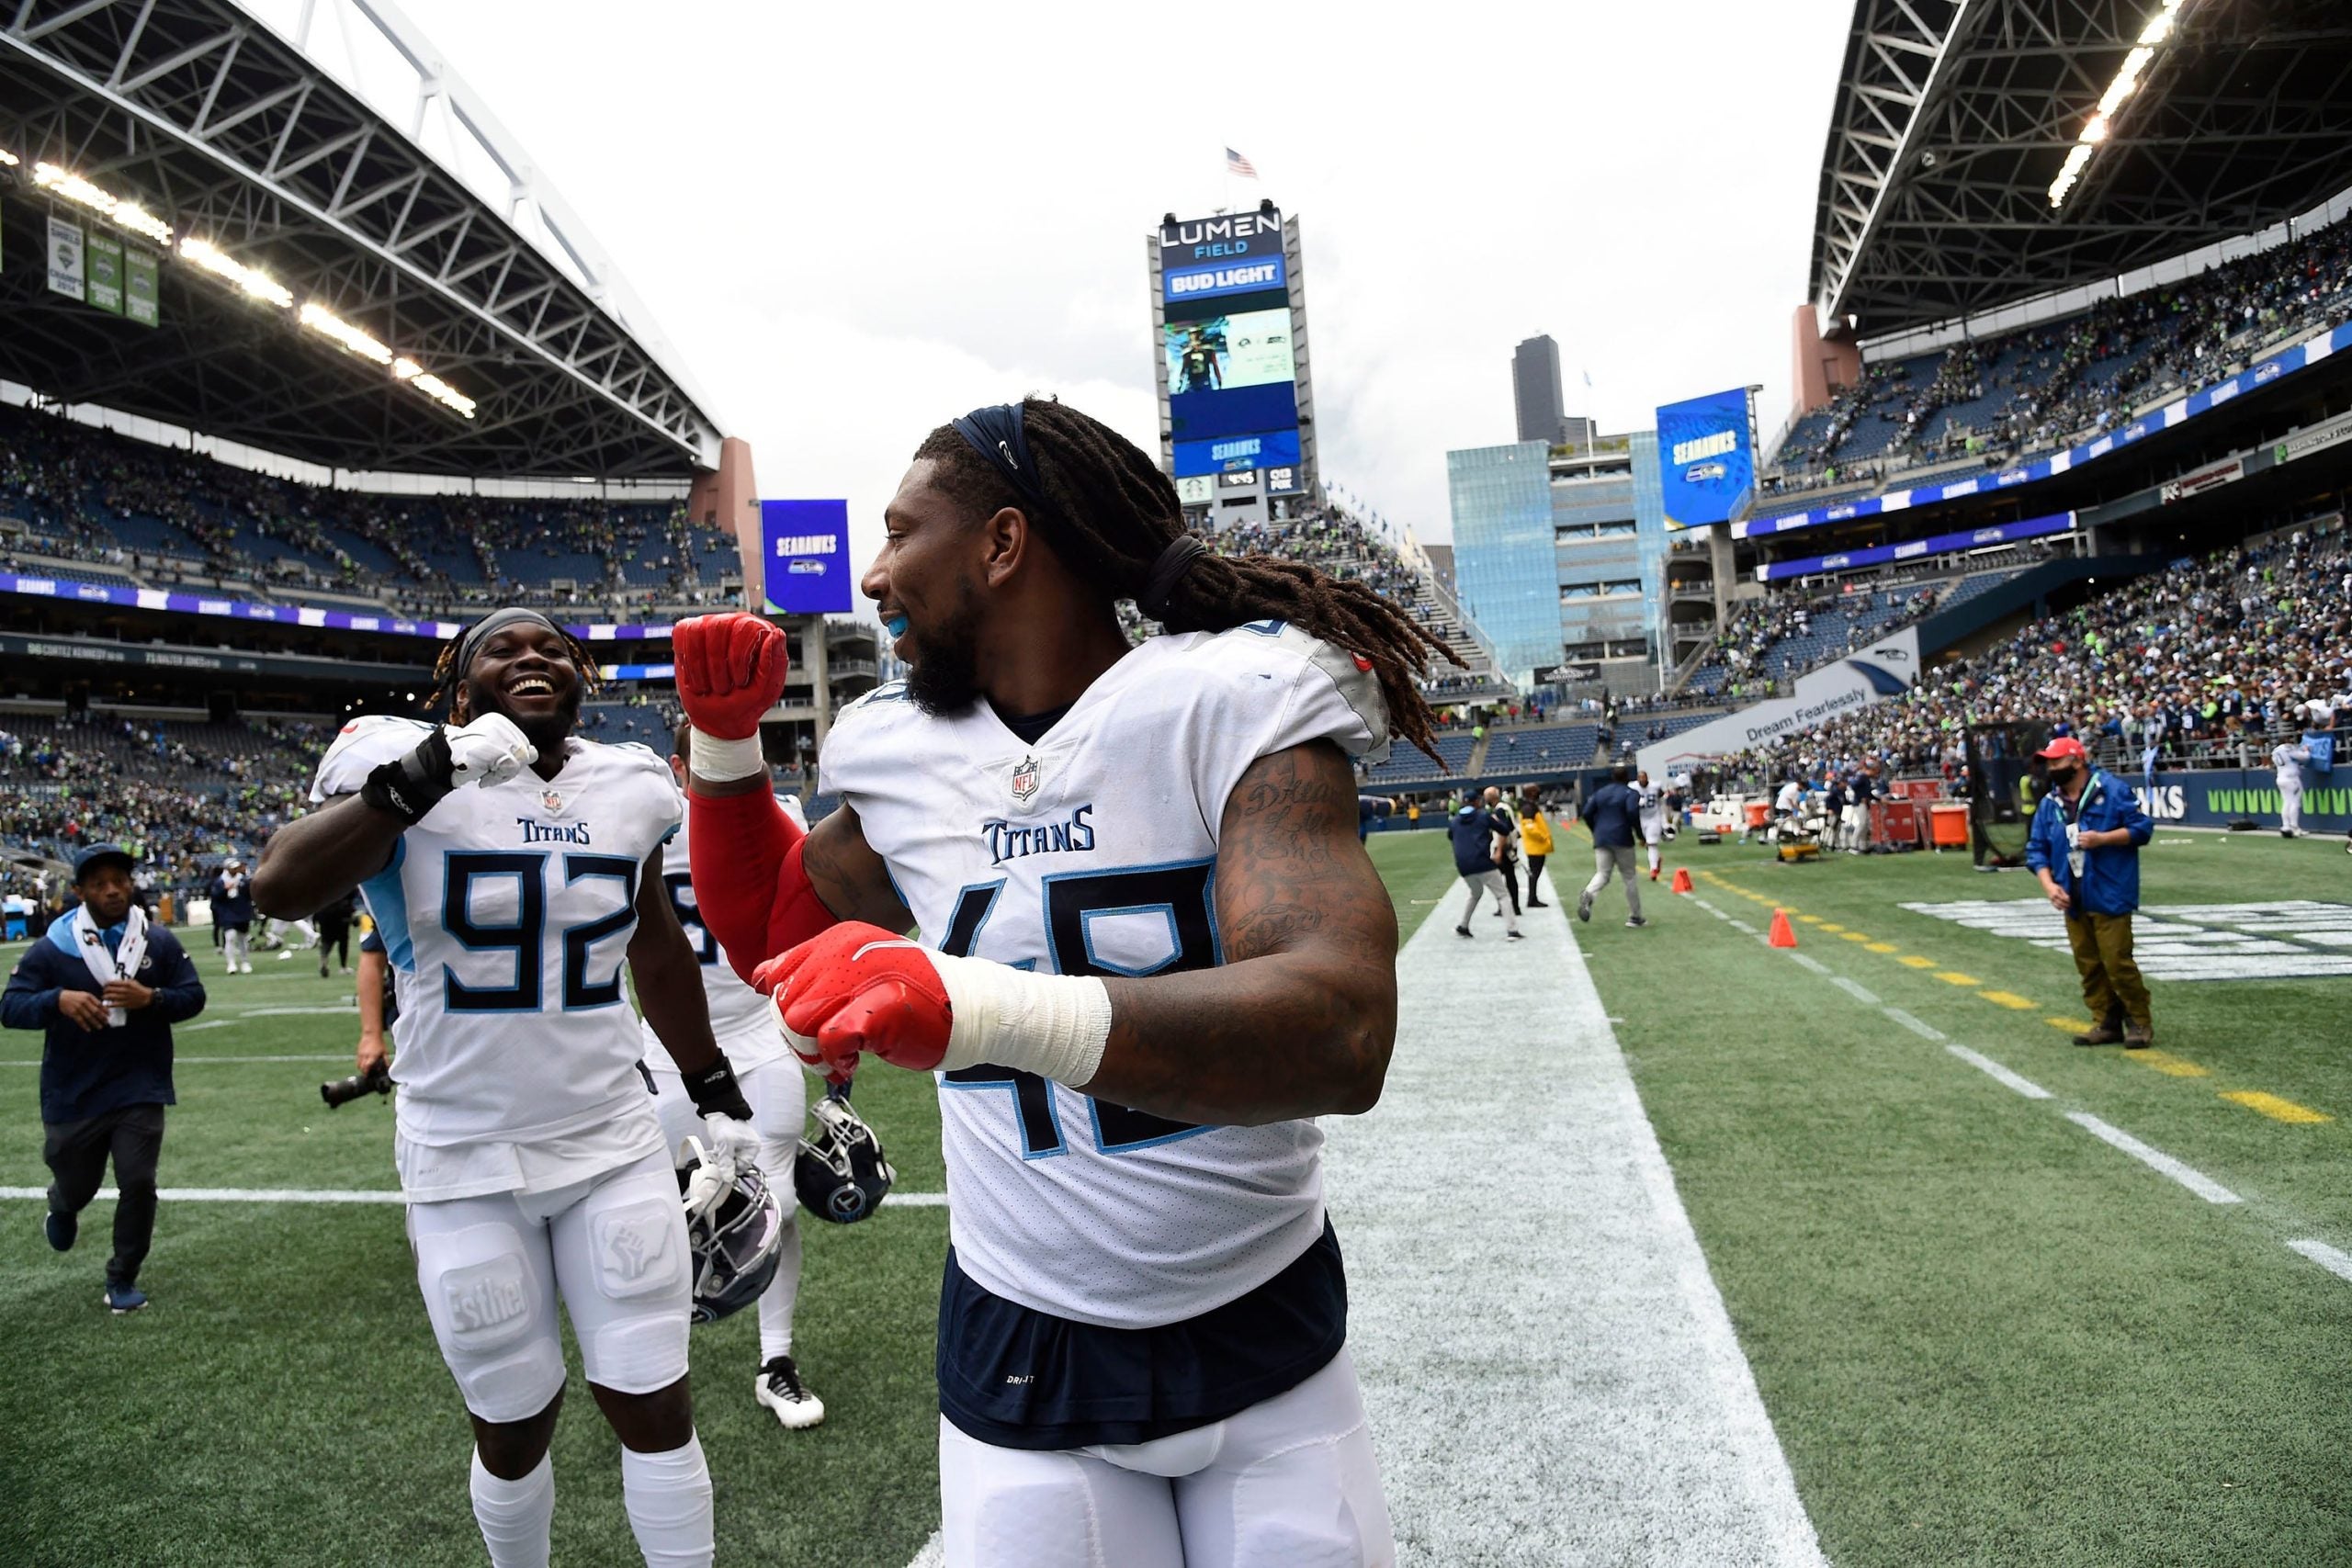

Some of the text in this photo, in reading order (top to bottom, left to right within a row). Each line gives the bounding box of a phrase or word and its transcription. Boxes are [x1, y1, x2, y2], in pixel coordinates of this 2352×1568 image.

[1160, 212, 1280, 247] LUMEN
[1194, 240, 1248, 259] FIELD
[1171, 264, 1276, 294] BUD LIGHT
[1673, 429, 1736, 466] SEAHAWKS
[776, 534, 836, 557] SEAHAWKS
[1747, 688, 1866, 742] Dream Fearlessly
[1014, 773, 1035, 792] NFL
[545, 796, 560, 807] NFL
[517, 818, 591, 845] TITANS
[982, 803, 1095, 865] TITANS
[442, 850, 639, 1014] 92
